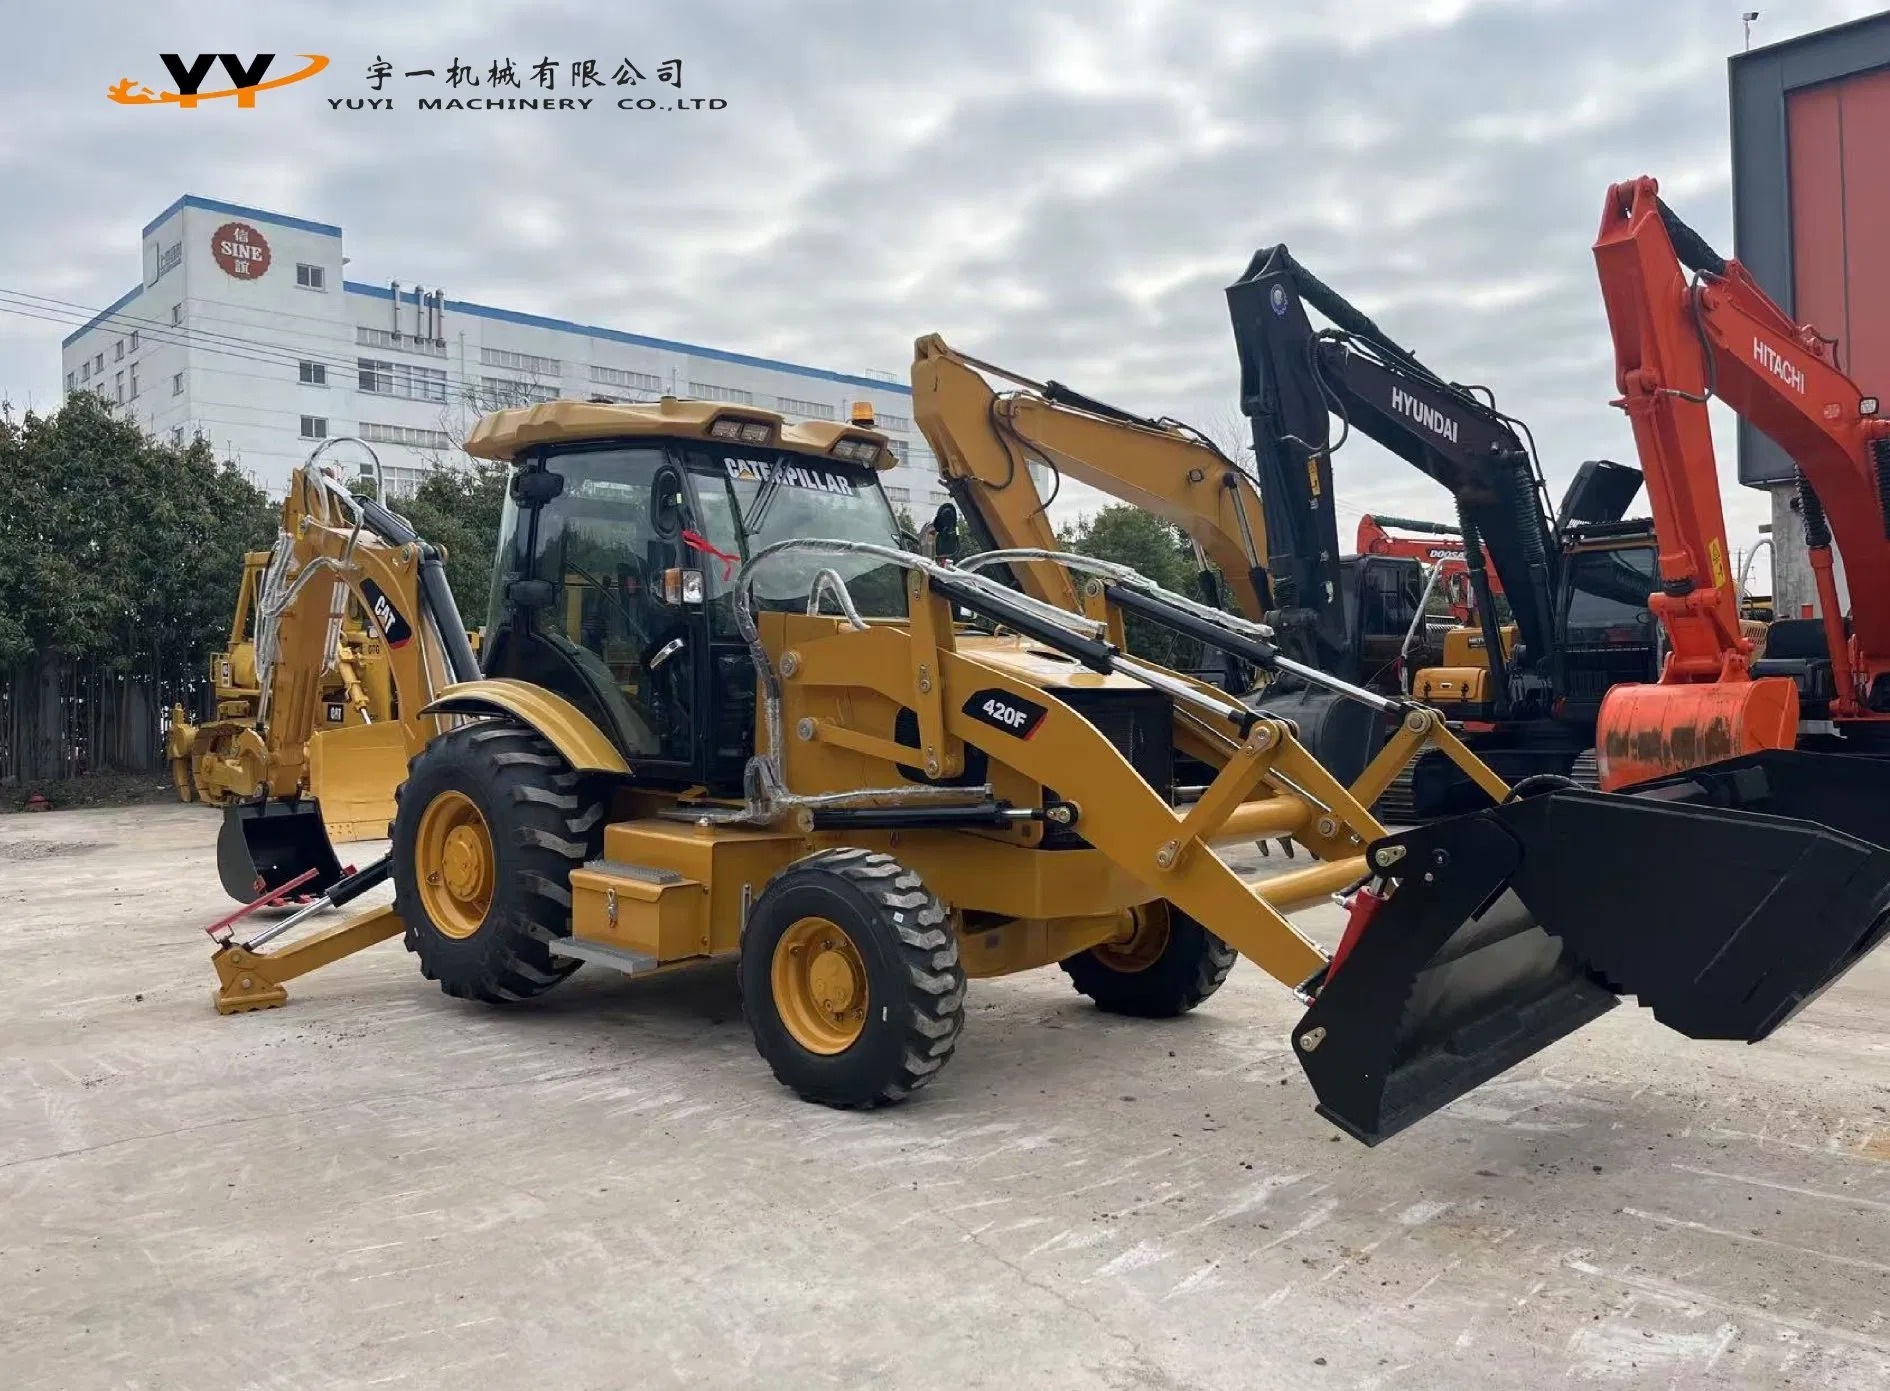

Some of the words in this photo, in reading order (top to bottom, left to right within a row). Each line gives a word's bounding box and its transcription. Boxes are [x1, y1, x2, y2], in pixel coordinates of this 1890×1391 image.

[221, 241, 262, 261] SINE
[1753, 336, 1805, 395] HITACHI
[1392, 386, 1459, 444] HYUNDAI
[374, 595, 396, 635] CAT
[982, 699, 1028, 729] 420F
